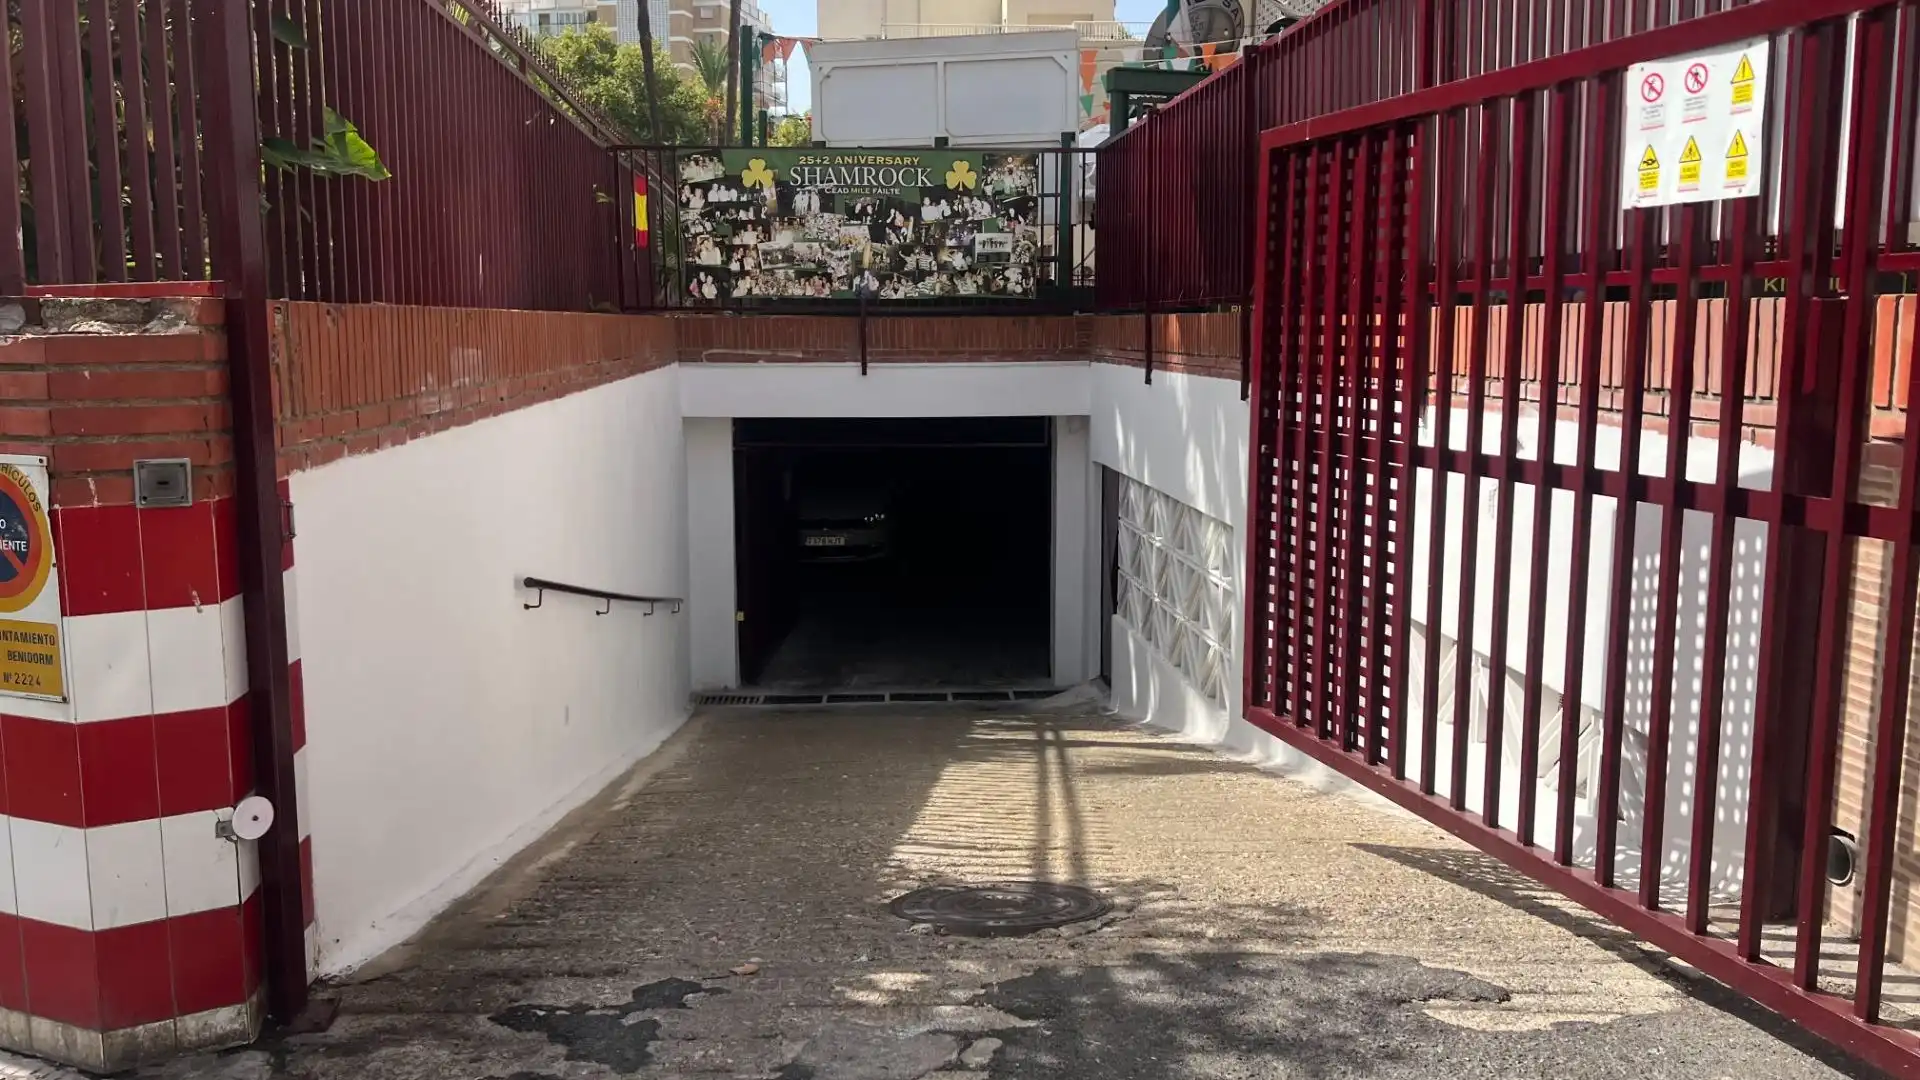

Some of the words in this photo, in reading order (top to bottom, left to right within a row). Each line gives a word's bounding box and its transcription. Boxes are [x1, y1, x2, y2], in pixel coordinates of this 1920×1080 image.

[799, 156, 830, 165] 25+2
[834, 156, 920, 166] ANIVERSARY
[789, 166, 934, 187] SHAMROCK
[7, 650, 54, 665] BENIDORM
